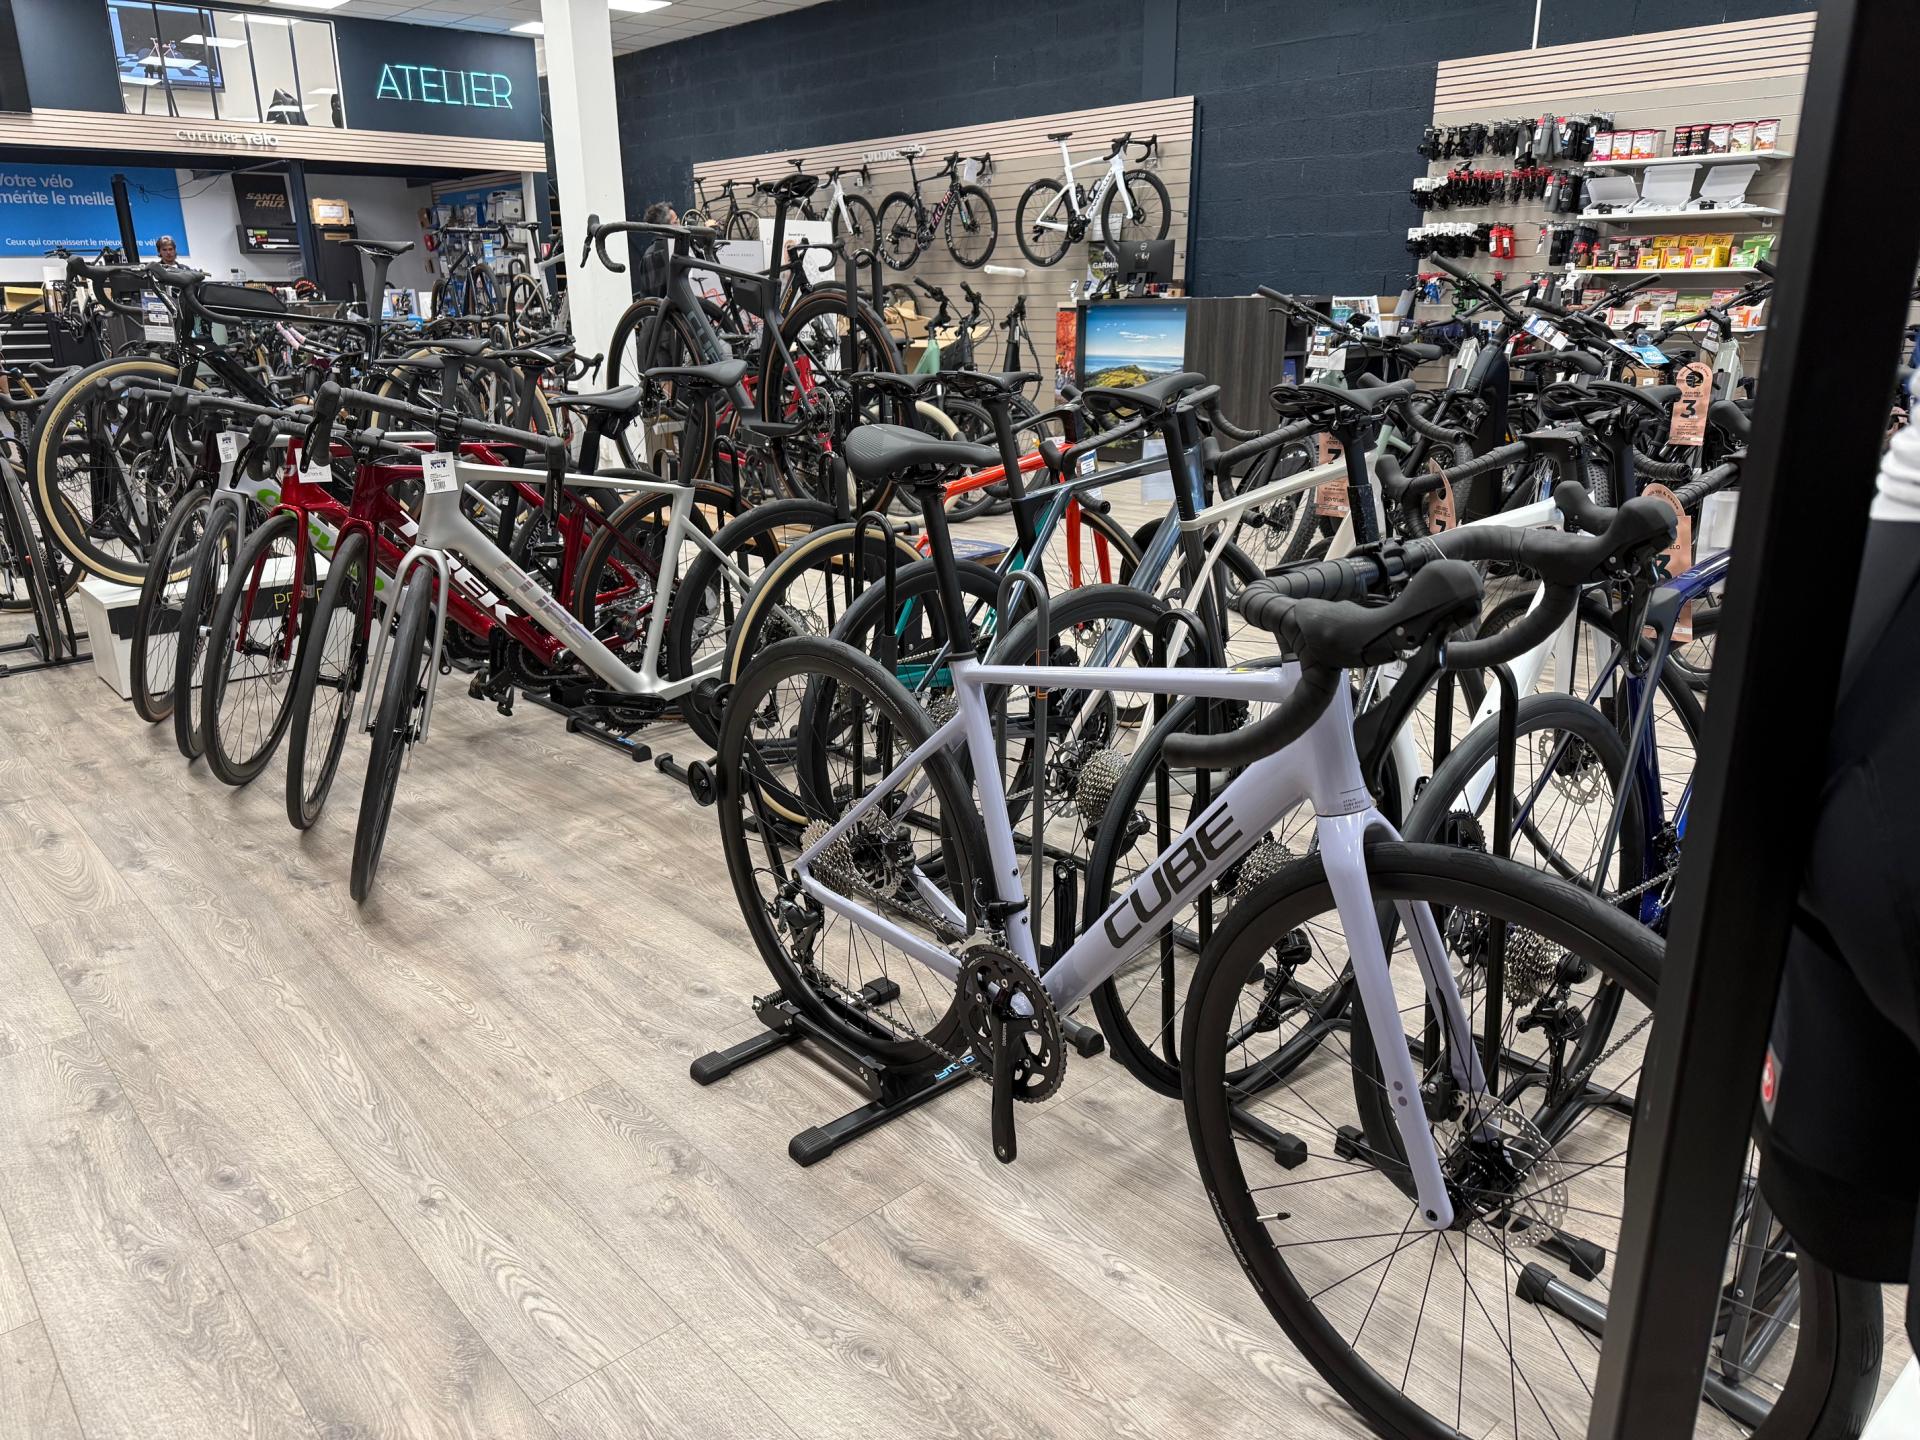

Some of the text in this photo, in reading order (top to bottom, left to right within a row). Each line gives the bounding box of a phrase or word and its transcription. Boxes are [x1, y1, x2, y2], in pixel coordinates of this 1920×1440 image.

[376, 63, 513, 110] ATELIER
[176, 130, 238, 143] CULTURE
[40, 174, 74, 189] vélo
[0, 191, 132, 206] mérite le meille.
[246, 192, 285, 201] SANTA
[255, 200, 288, 208] CRUZ
[5, 237, 27, 246] Ceux
[28, 238, 41, 248] qui
[42, 238, 89, 247] connaissent
[89, 238, 98, 246] le
[144, 238, 158, 247] vél
[1680, 399, 1697, 419] 3
[494, 561, 594, 649] CUBE
[1104, 801, 1244, 949] CUBE
